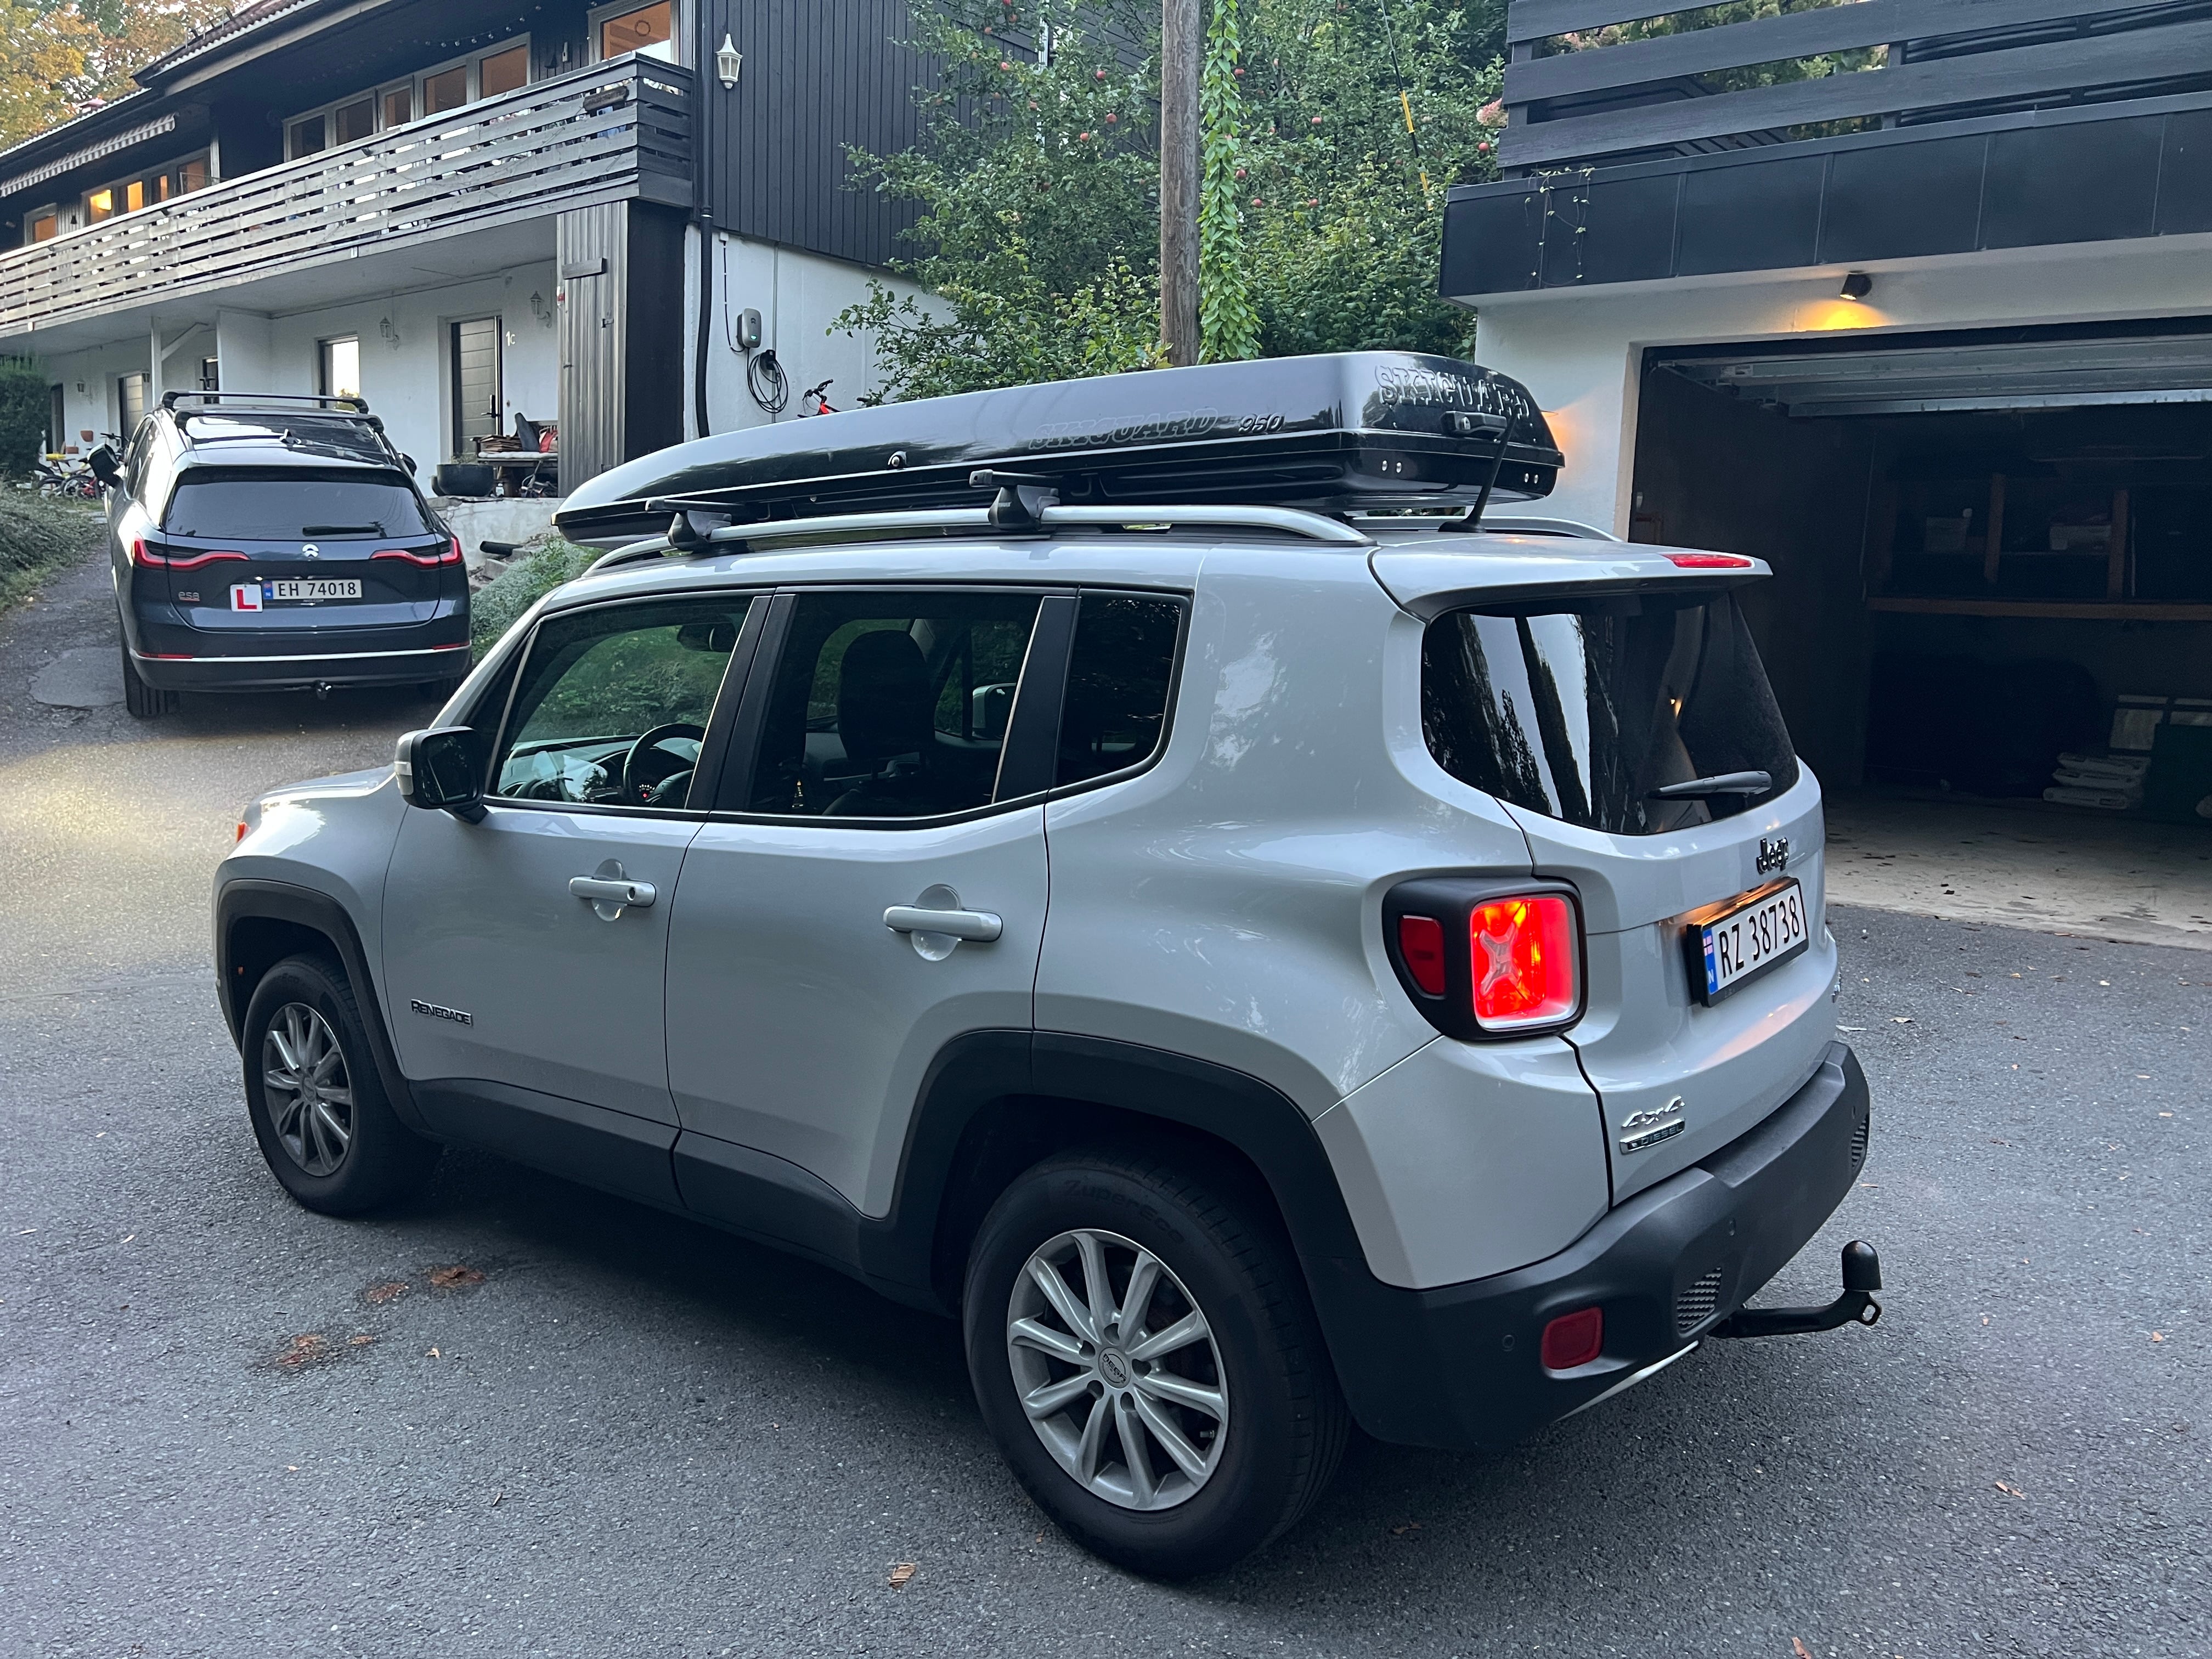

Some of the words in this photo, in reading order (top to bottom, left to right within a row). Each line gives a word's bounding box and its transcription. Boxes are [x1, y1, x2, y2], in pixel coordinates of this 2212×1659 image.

[1028, 408, 1218, 450] SKIGUARD
[1238, 413, 1286, 434] 950
[236, 589, 257, 610] L
[278, 583, 299, 597] EH
[307, 582, 356, 596] 74018
[1756, 837, 1789, 875] Jeep
[1718, 923, 1745, 979] RZ
[1748, 895, 1800, 961] 38738
[1707, 968, 1714, 984] N
[1640, 1125, 1684, 1146] DIESEL
